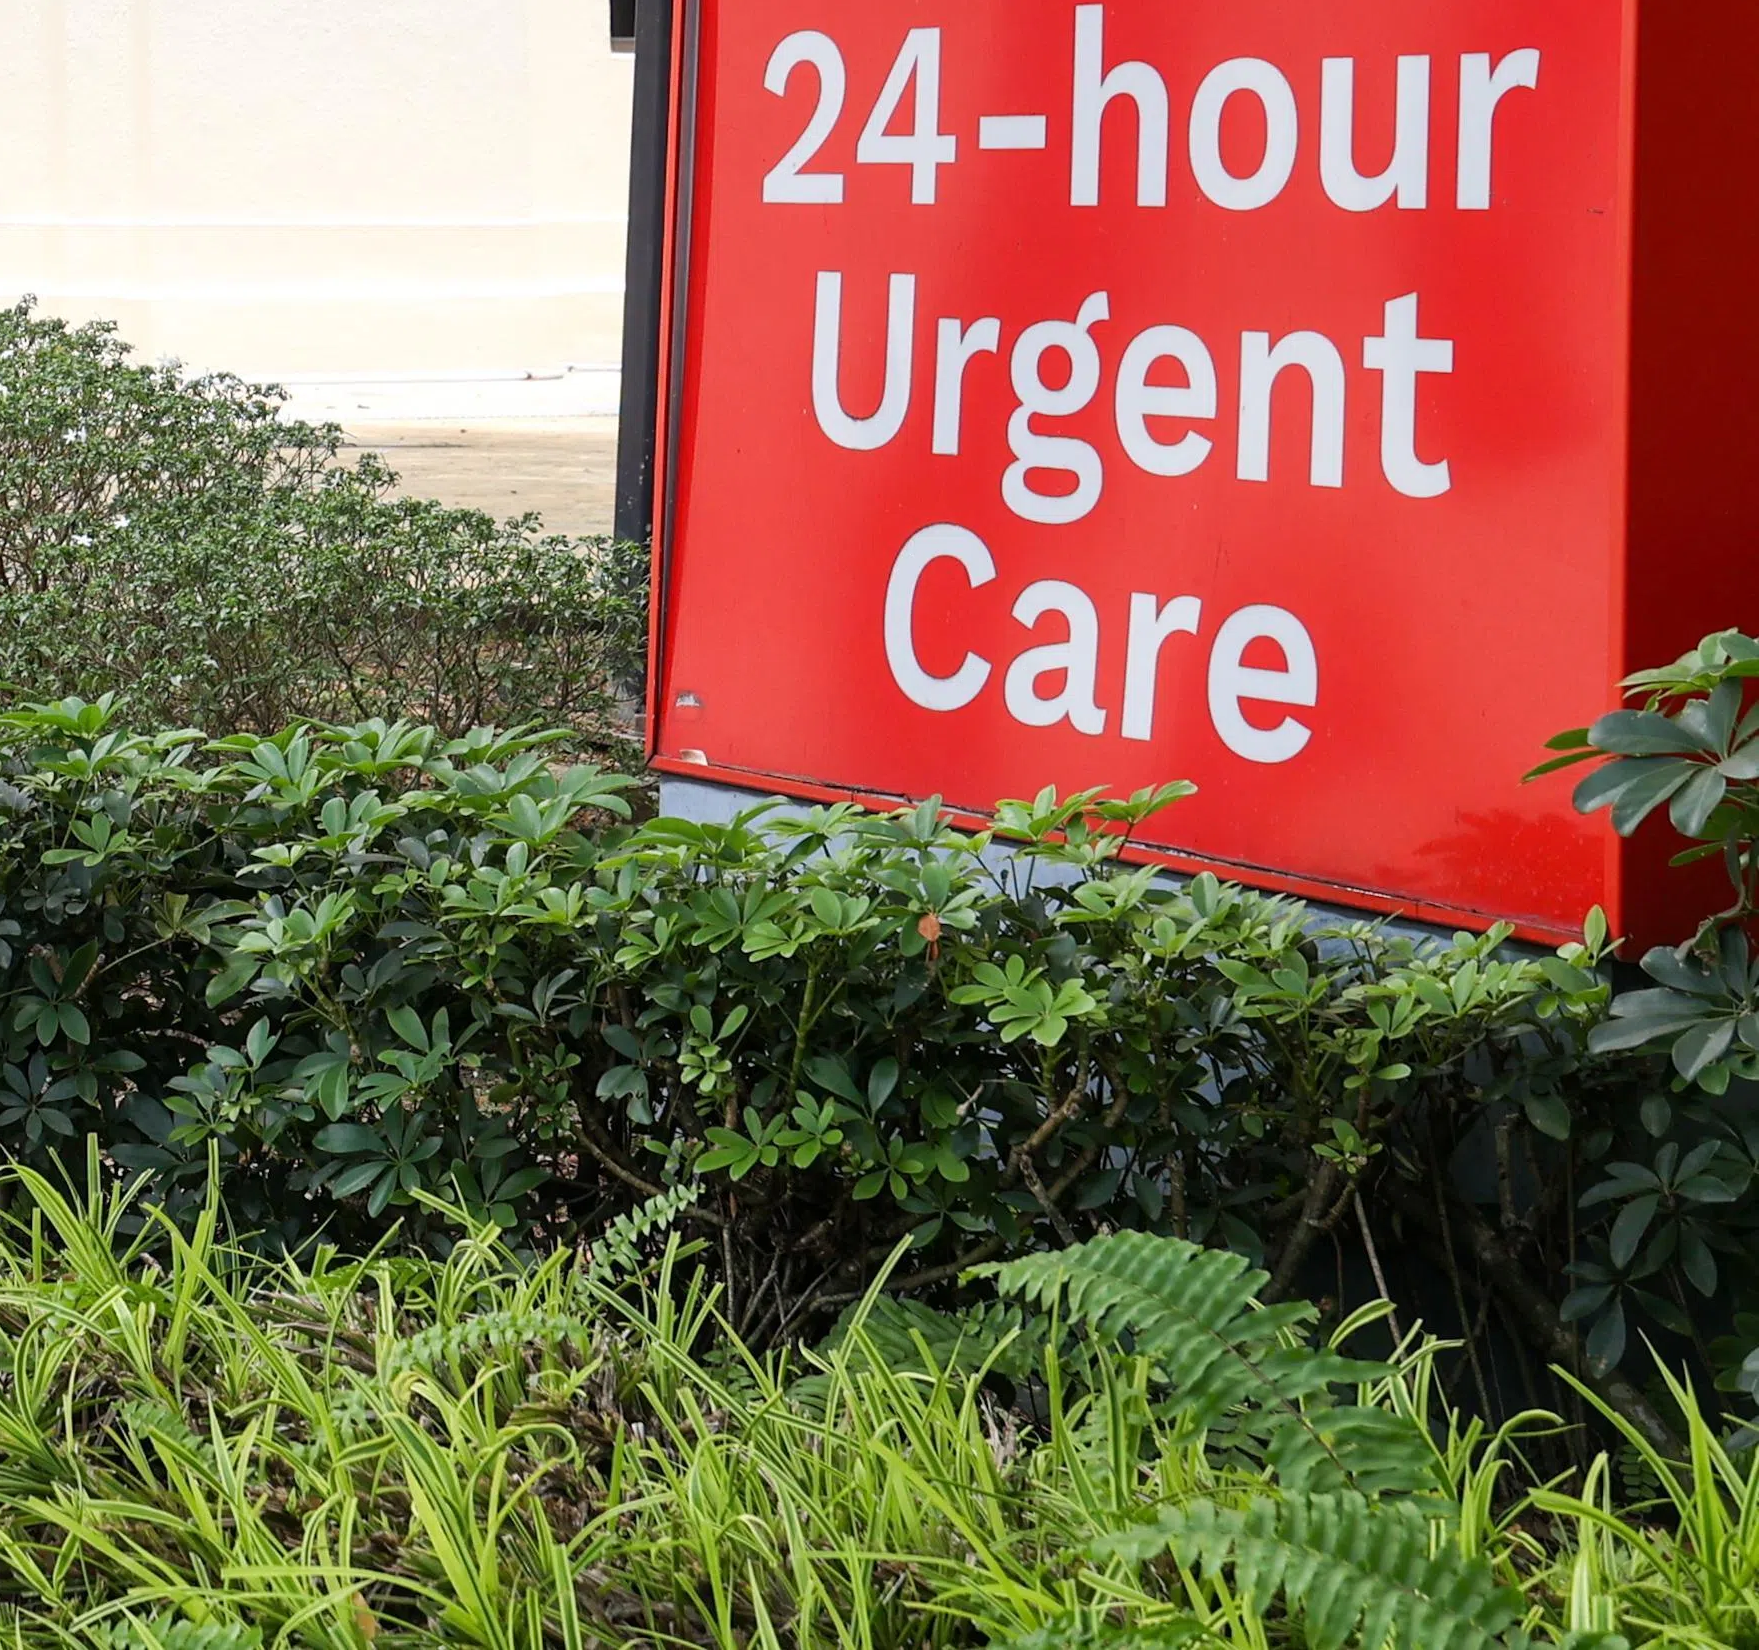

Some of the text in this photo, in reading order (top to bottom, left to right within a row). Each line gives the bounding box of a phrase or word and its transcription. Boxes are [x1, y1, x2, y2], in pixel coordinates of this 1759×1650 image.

[761, 3, 1541, 211] 24-hour
[810, 270, 1454, 526] Urgent
[884, 522, 1319, 764] Care
